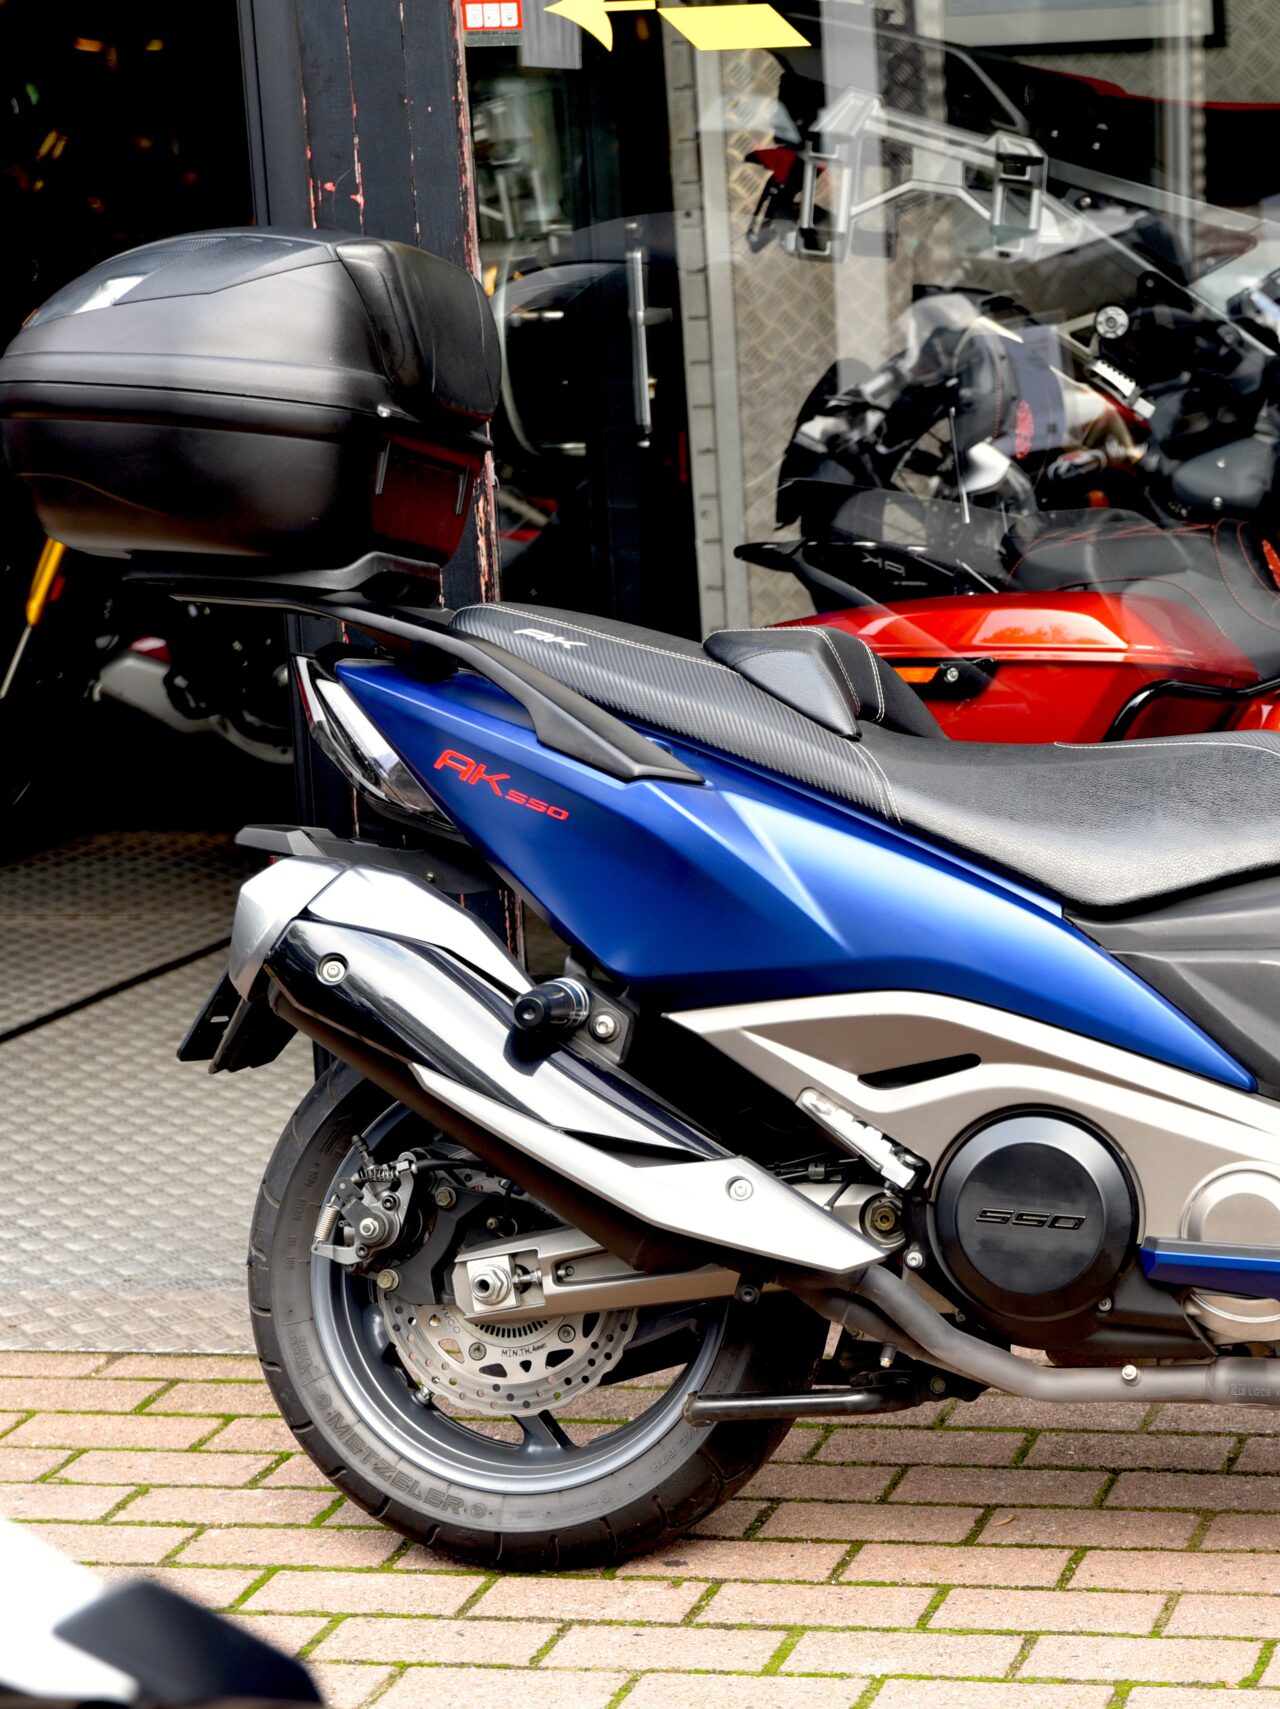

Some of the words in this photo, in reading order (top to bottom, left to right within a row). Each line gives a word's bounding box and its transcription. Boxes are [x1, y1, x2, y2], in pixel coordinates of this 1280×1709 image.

[433, 749, 511, 797] AK
[505, 789, 570, 821] 550
[975, 1207, 1087, 1231] 550
[440, 1304, 461, 1334] YMCO
[326, 1410, 466, 1516] METZELER
